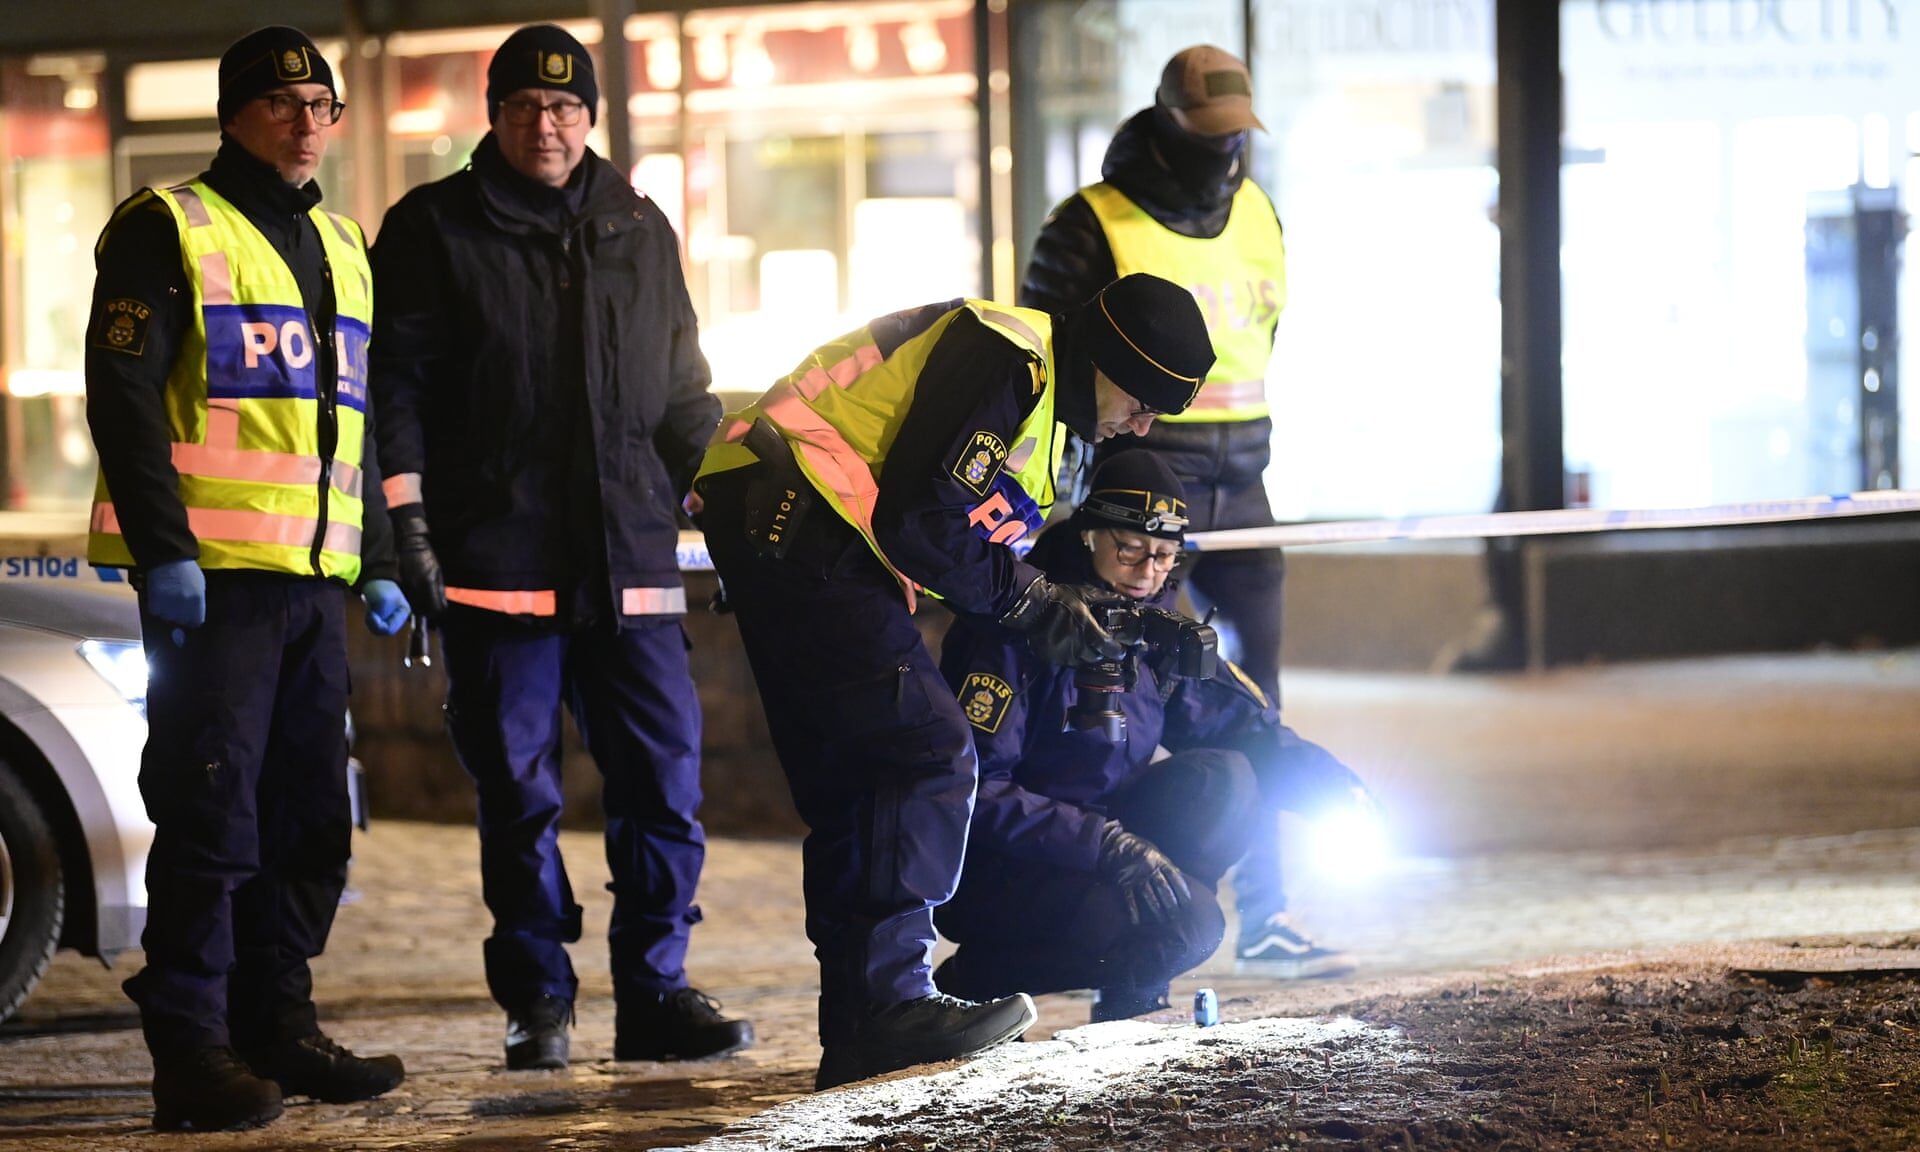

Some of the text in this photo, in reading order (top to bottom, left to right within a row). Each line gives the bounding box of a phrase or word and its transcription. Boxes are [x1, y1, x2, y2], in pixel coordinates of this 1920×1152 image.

[108, 301, 149, 320] POLIS
[976, 434, 1005, 460] POLIS
[769, 489, 796, 543] POLIS
[6, 556, 78, 578] POLIS
[971, 676, 1010, 699] POLIS
